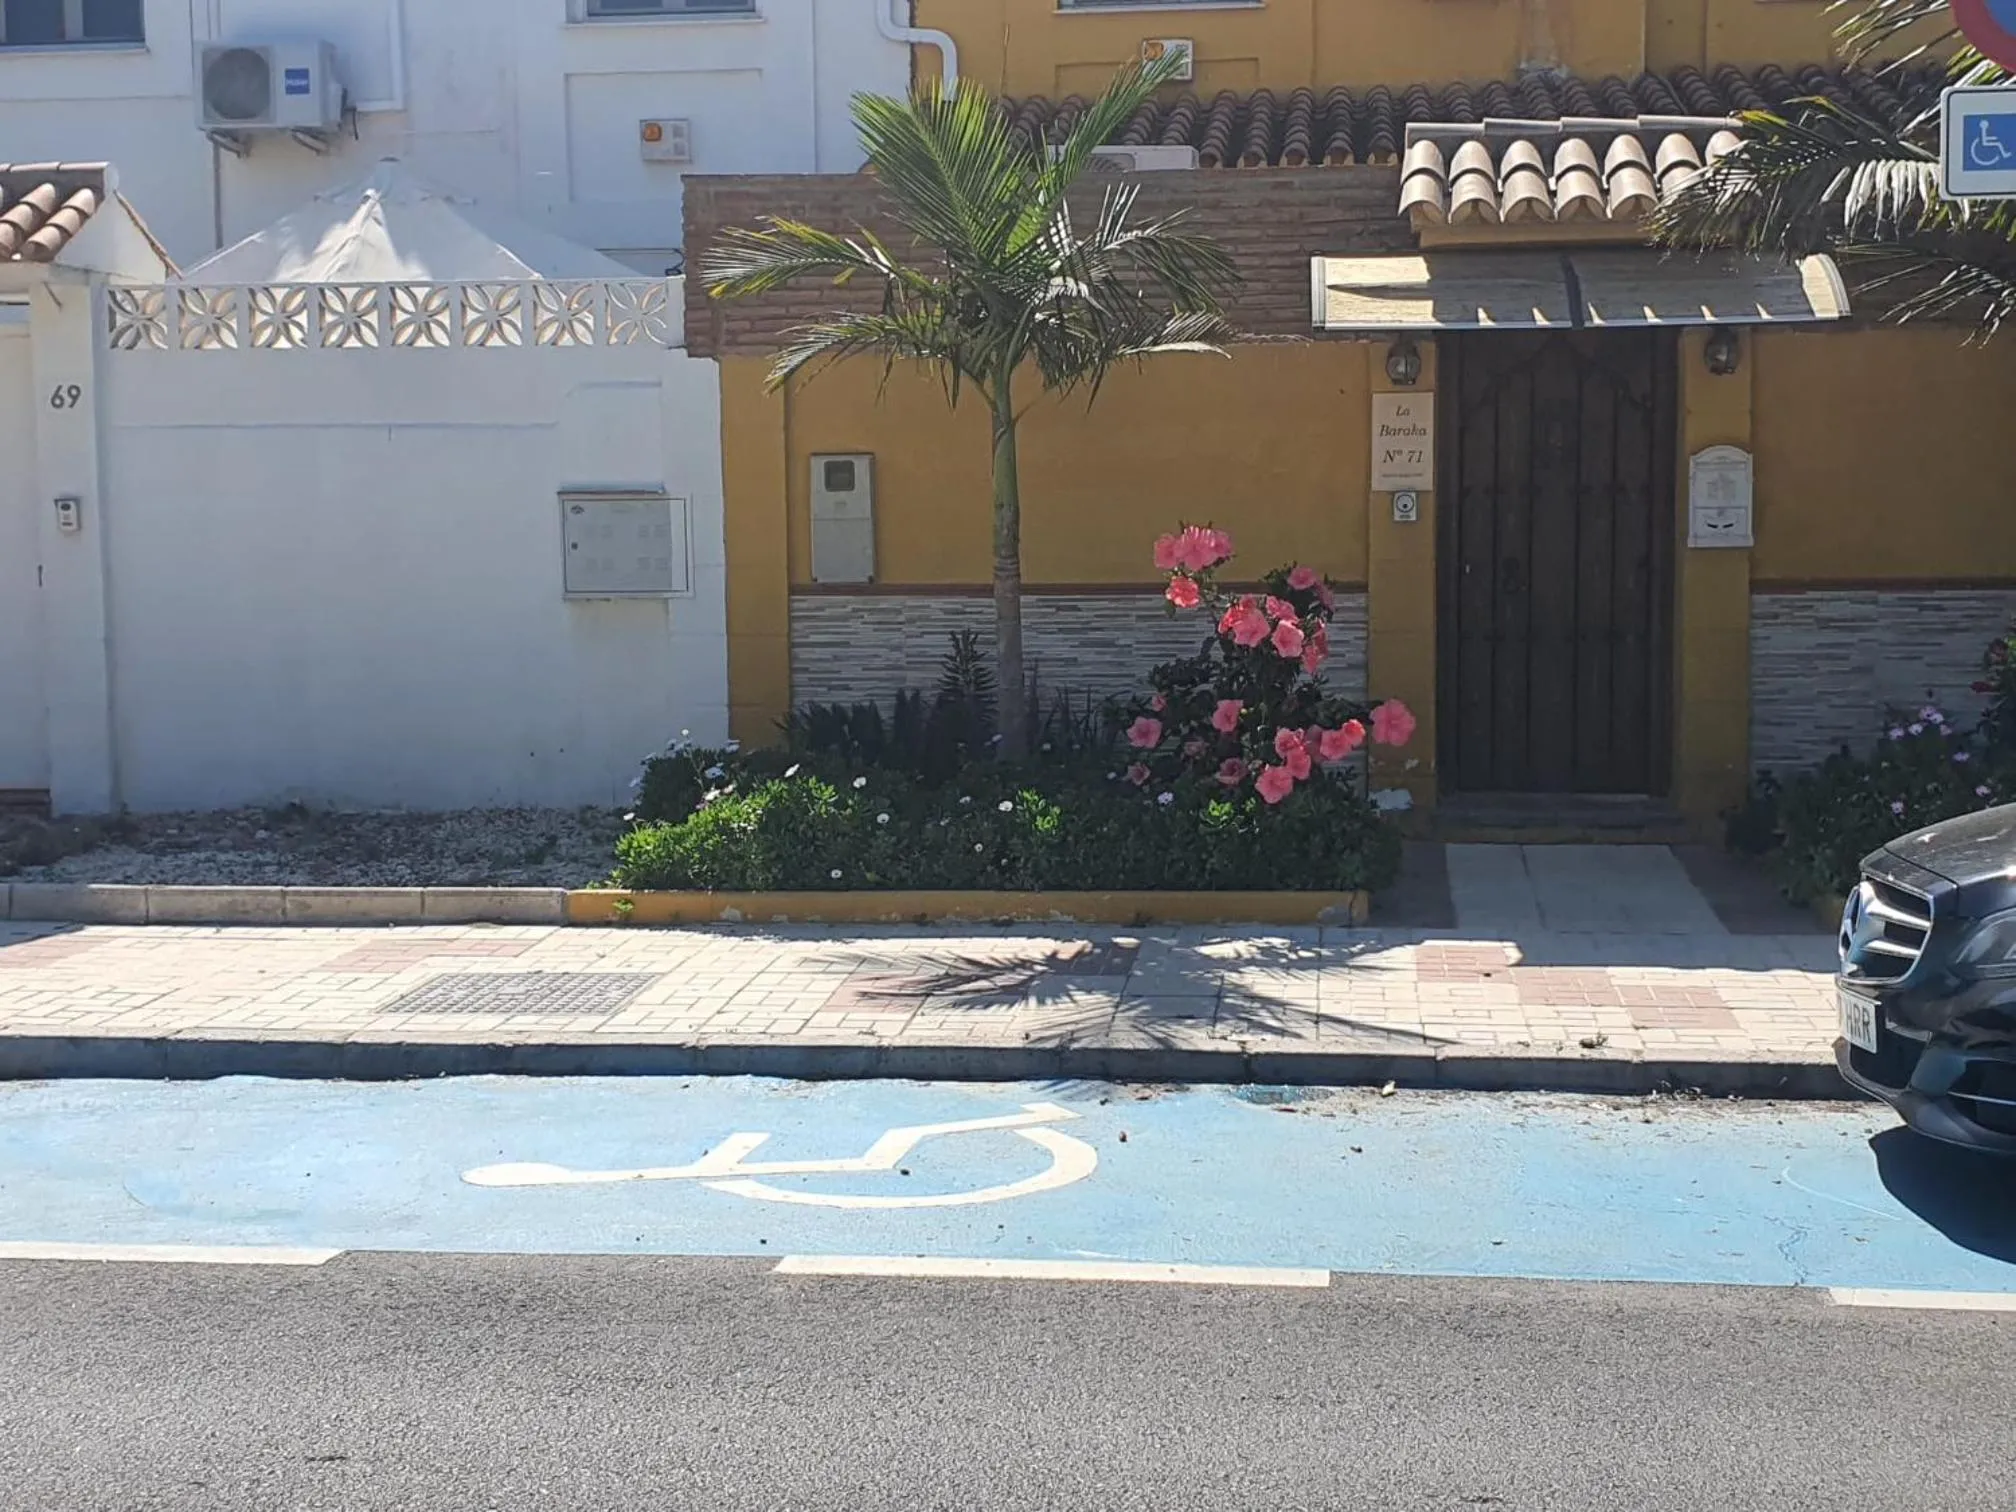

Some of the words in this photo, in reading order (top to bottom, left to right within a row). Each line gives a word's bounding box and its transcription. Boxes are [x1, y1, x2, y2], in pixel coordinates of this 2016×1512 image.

[51, 384, 82, 409] 69
[1396, 405, 1410, 417] La
[1380, 423, 1427, 437] Baraka
[1407, 449, 1424, 463] 71
